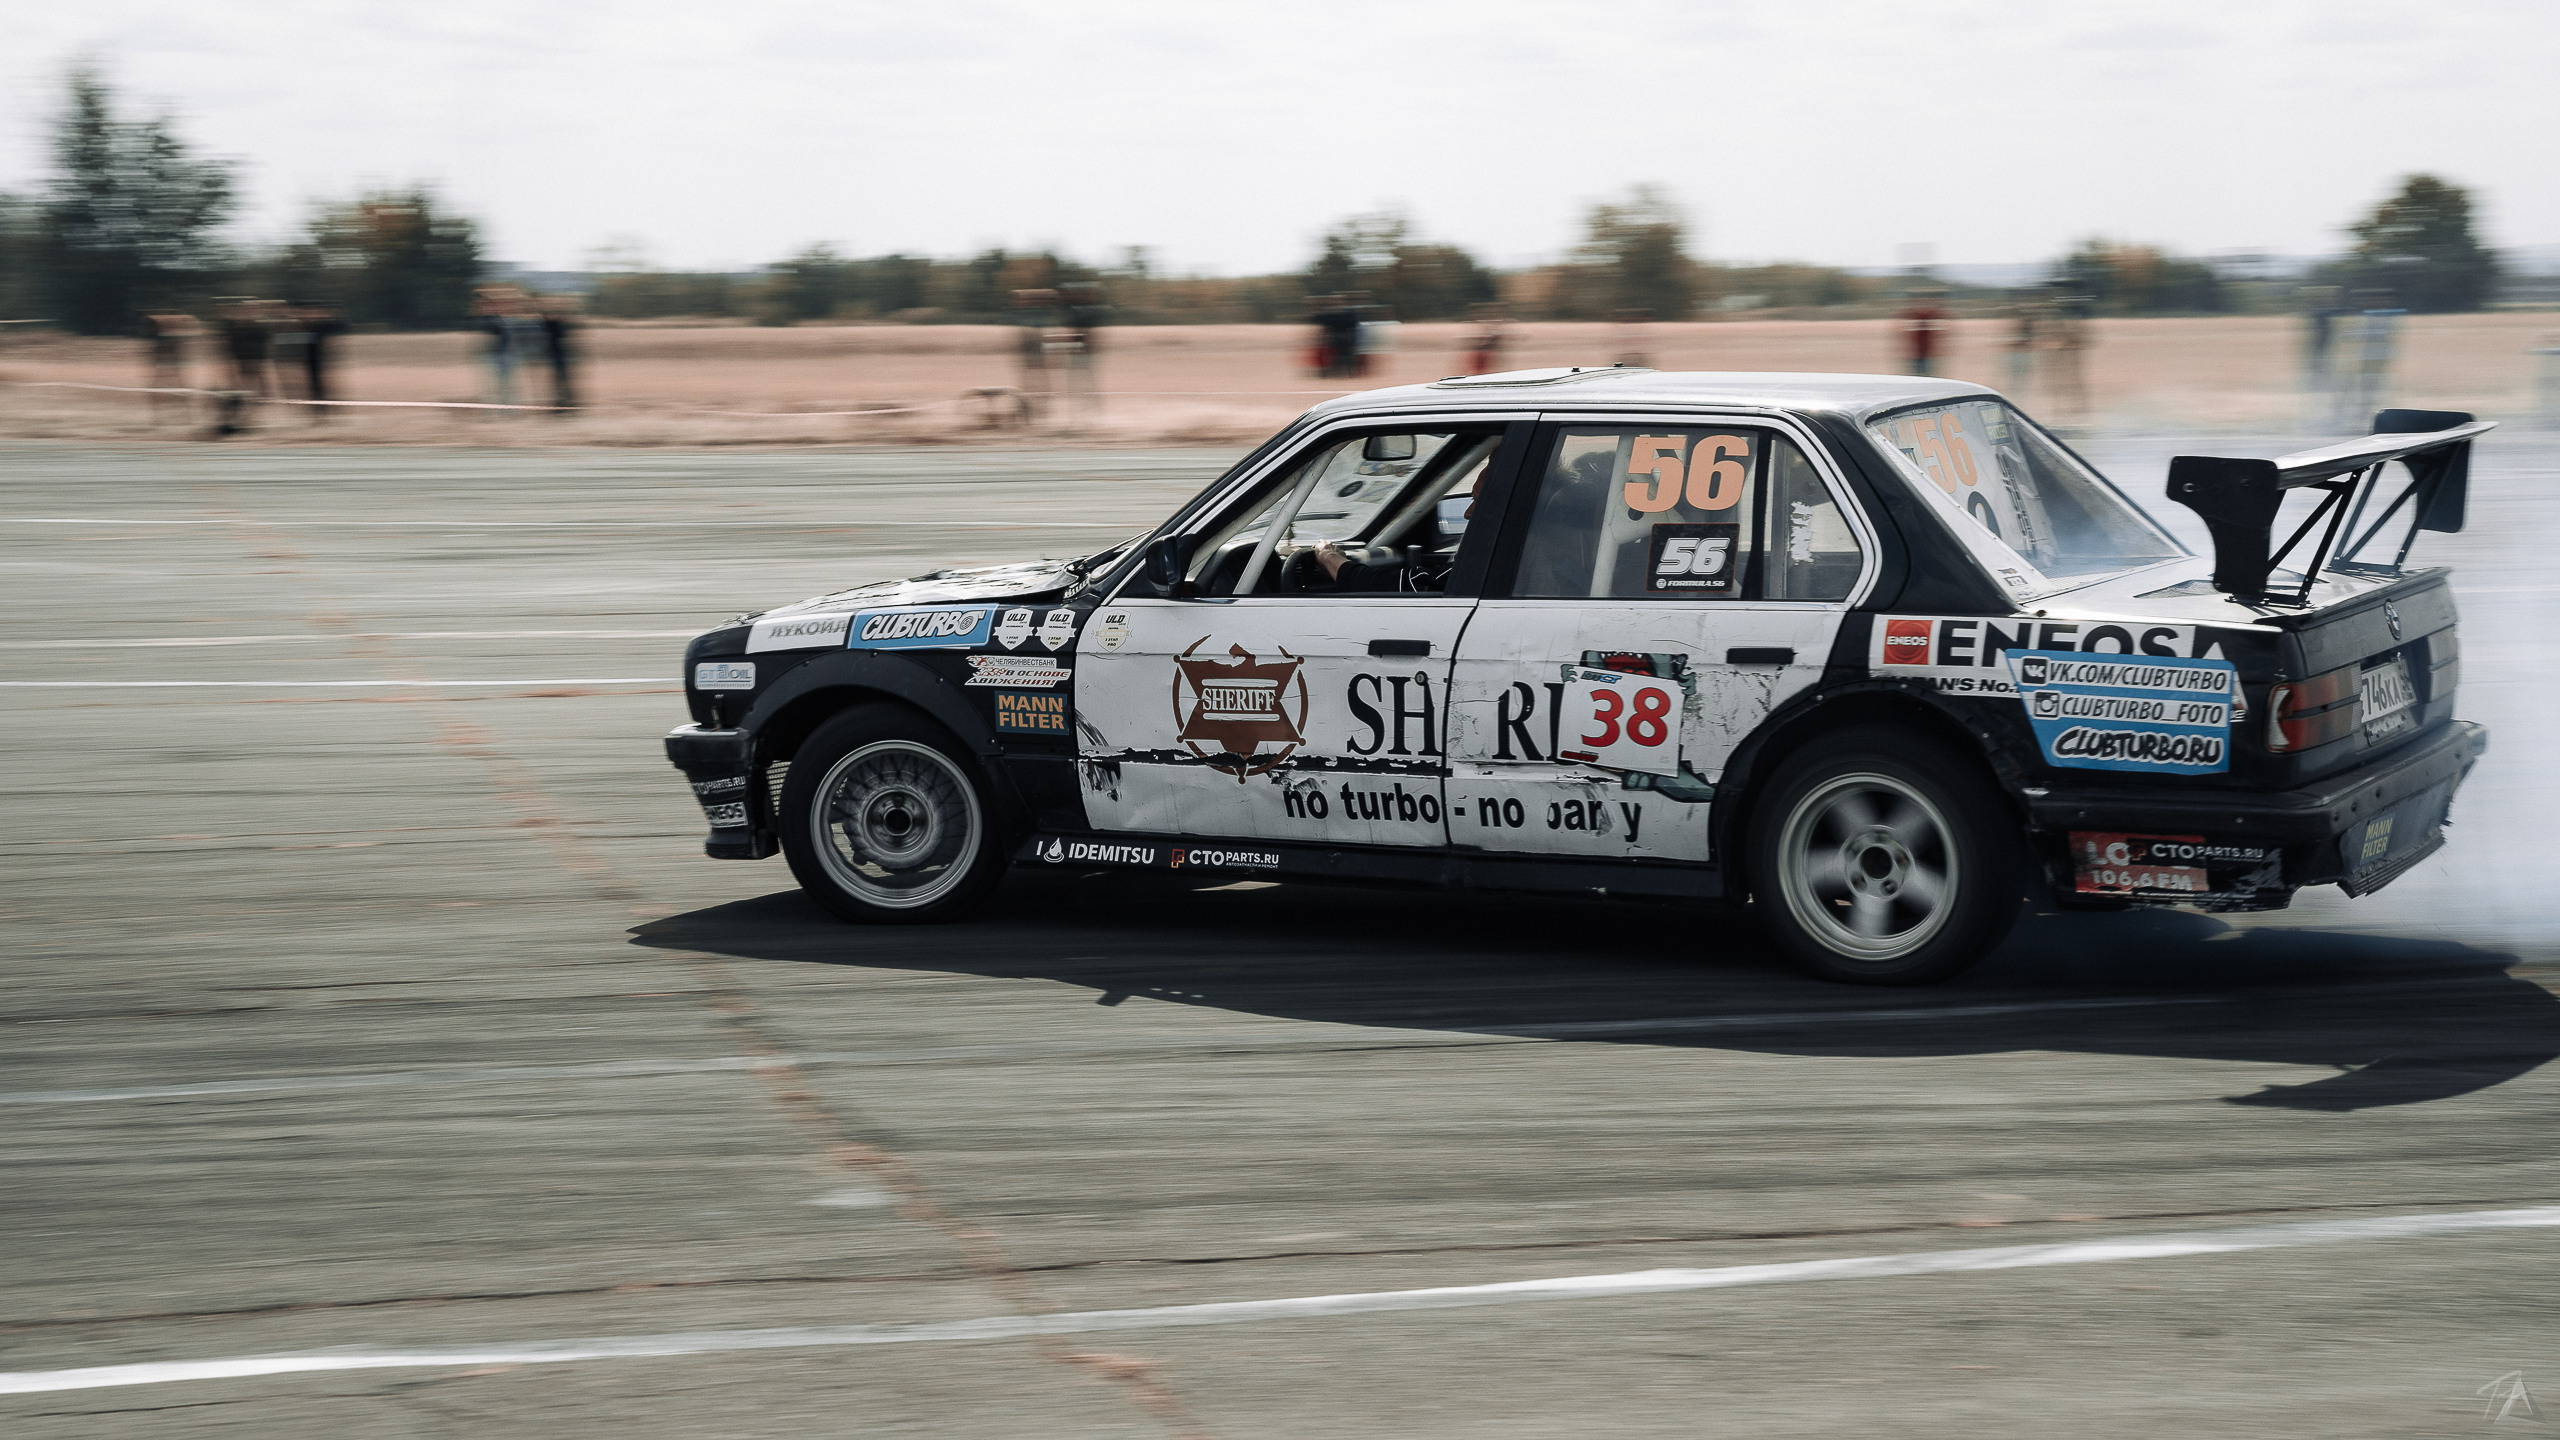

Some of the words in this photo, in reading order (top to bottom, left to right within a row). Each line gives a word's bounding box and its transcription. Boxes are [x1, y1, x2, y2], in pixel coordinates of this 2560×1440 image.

[1913, 413, 1978, 493] 56
[1624, 434, 1750, 513] 56
[1656, 538, 1730, 575] 56
[1007, 613, 1027, 622] ULD
[1050, 613, 1070, 622] ULD
[1105, 614, 1126, 624] ULD
[1886, 635, 1928, 647] ENEOS
[996, 657, 1055, 666] ЧЕЛЯБИНВЕСТБАНК
[967, 677, 1055, 686] ДВИЖЕНИЯ!
[1017, 670, 1070, 678] ОСНОВЕ
[2051, 662, 2227, 691] VK.COM/CLUBTURBO
[998, 694, 1064, 713] MANN
[1202, 687, 1277, 712] SHERIFF
[2062, 696, 2223, 725] CLUBTURBO_FOTO
[999, 711, 1065, 730] FILTER
[1581, 686, 1671, 748] 38
[2054, 727, 2222, 765] CLUBTURBO.RU
[1283, 786, 1330, 820] no
[1341, 782, 1441, 824] turbo
[1478, 796, 1526, 828] no
[1547, 799, 1642, 843] ary
[2365, 817, 2393, 841] MANN
[1068, 842, 1155, 865] IDEMITSU
[2361, 836, 2389, 860] FILTER
[2091, 869, 2154, 888] 106.6
[2157, 873, 2193, 891] FM
